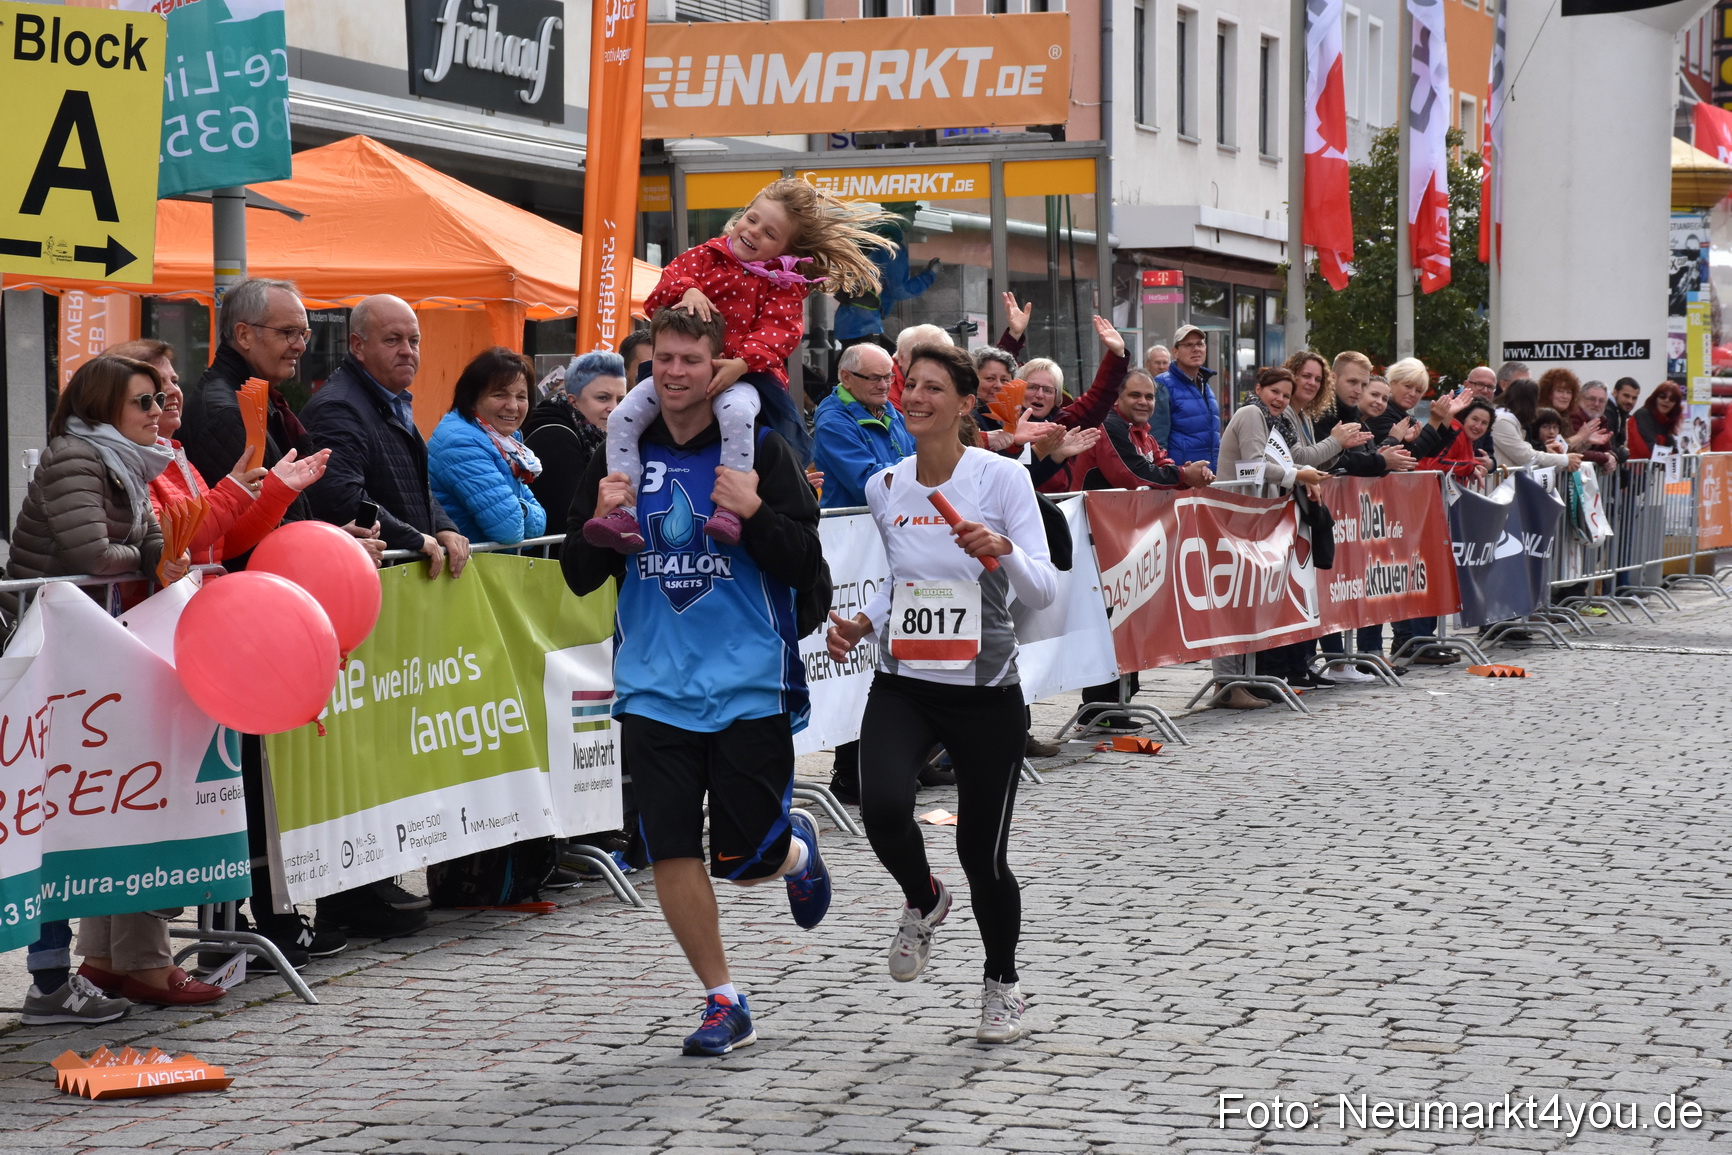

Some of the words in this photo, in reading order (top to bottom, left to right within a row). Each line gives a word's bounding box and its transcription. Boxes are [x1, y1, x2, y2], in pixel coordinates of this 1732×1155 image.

[14, 14, 149, 72] Block
[424, 0, 563, 104] frühauf
[643, 46, 1047, 108] RUNMARKT.DE
[19, 89, 120, 222] A
[309, 311, 328, 322] Modern
[328, 312, 346, 323] Women
[1503, 341, 1645, 360] www.MINI-Partl.de
[1134, 540, 1162, 599] NEUE
[921, 588, 954, 597] BOCK
[902, 607, 967, 635] 8017
[372, 656, 424, 703] weiß,
[428, 646, 482, 690] wo's
[196, 790, 217, 805] Jura
[407, 820, 425, 833] über
[426, 814, 441, 828] 500
[409, 830, 448, 849] Parkplätze
